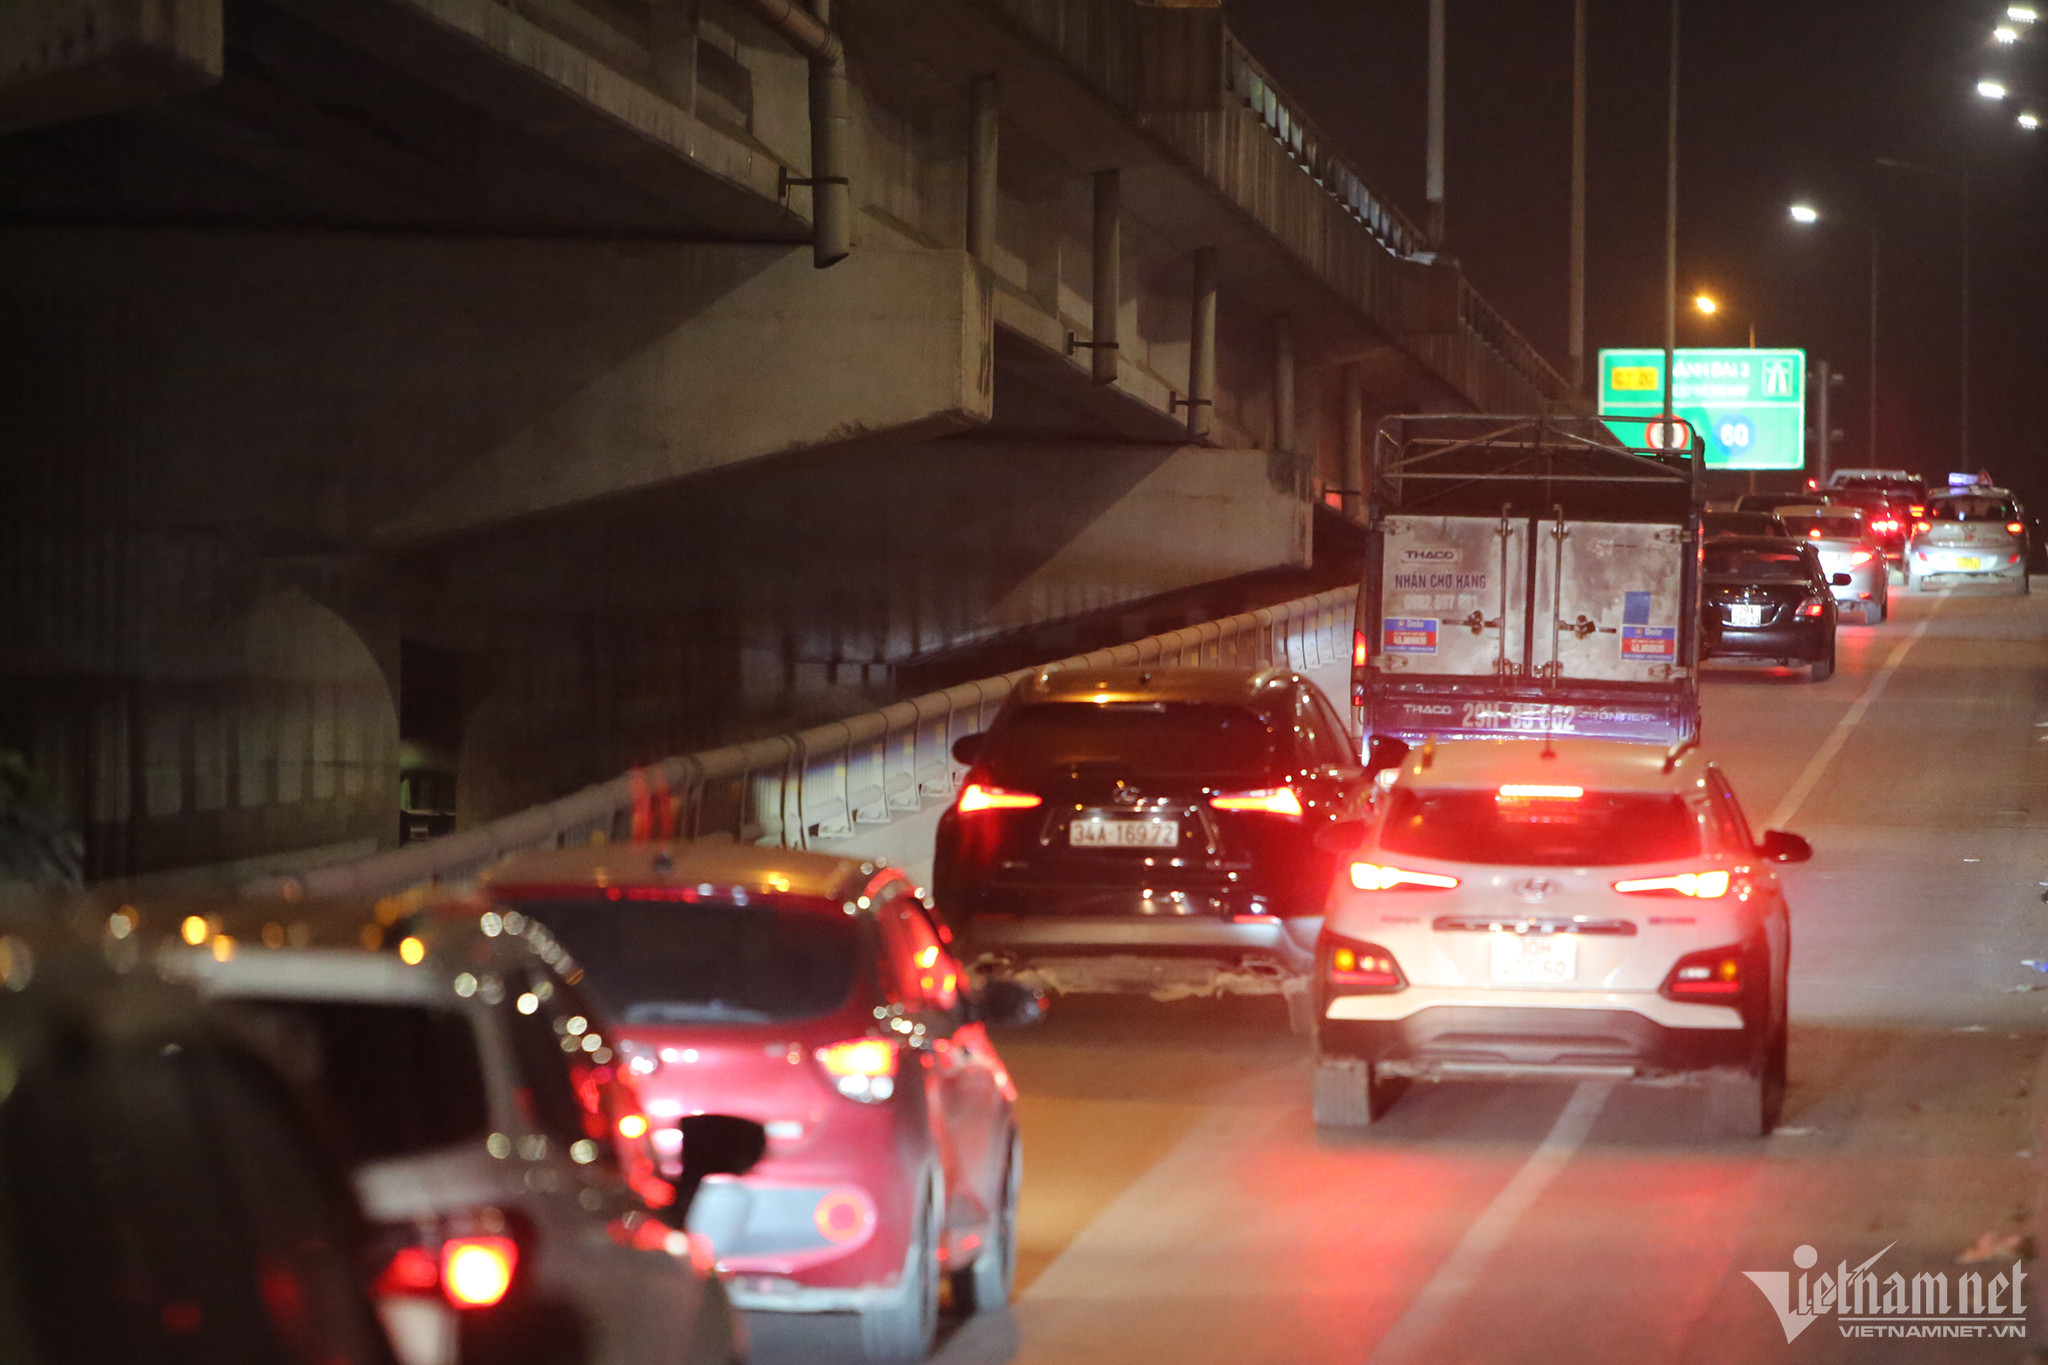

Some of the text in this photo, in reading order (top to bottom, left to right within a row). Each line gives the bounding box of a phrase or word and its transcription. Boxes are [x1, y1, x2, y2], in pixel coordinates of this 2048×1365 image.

[1720, 423, 1749, 447] 60
[1405, 550, 1454, 559] THACO
[1403, 704, 1452, 715] THACO
